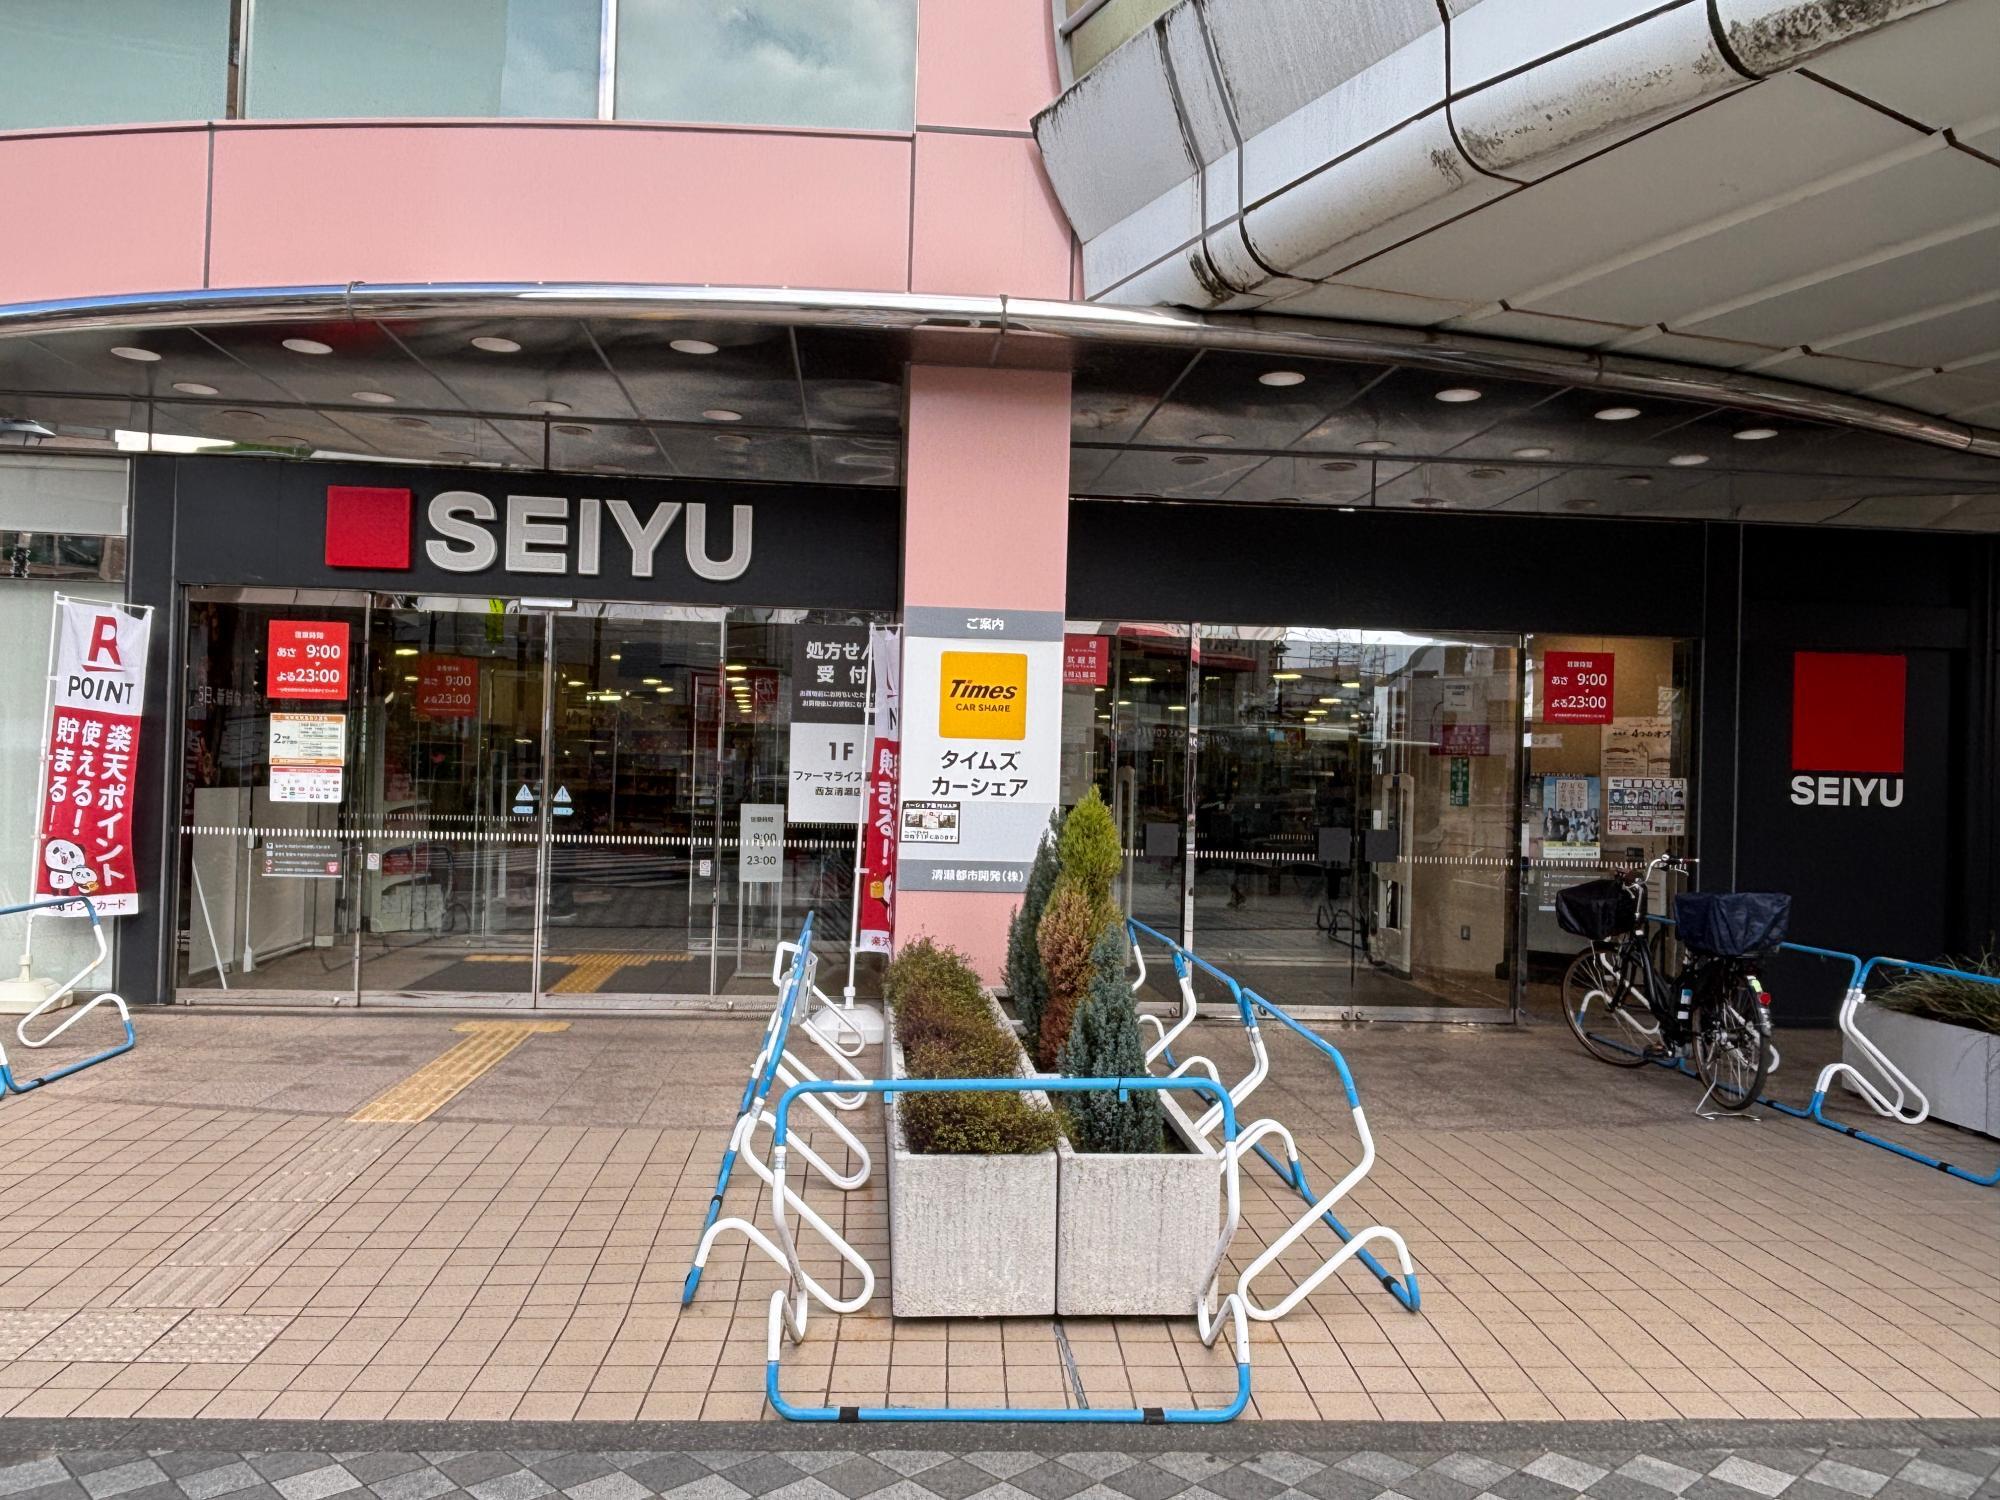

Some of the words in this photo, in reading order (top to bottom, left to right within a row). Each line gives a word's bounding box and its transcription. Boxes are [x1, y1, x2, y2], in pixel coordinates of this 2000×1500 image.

[426, 491, 753, 581] SEIYU
[966, 617, 1004, 631] ご案内
[87, 615, 121, 667] R
[276, 647, 297, 657] あさ
[306, 644, 341, 659] 9:00
[68, 675, 135, 704] POINT
[445, 675, 472, 686] 9:00
[949, 679, 1018, 700] Times
[1577, 673, 1607, 686] 9:00
[955, 703, 976, 712] CAR
[978, 704, 1011, 713] SHARE
[940, 750, 1022, 771] タイムズ
[48, 716, 79, 832] 貯まる！
[72, 719, 104, 836] 使える！
[931, 776, 1028, 797] カーシェア
[1790, 775, 1904, 808] SEIYU
[96, 724, 132, 886] 楽天ポイント
[746, 855, 777, 865] 23:00
